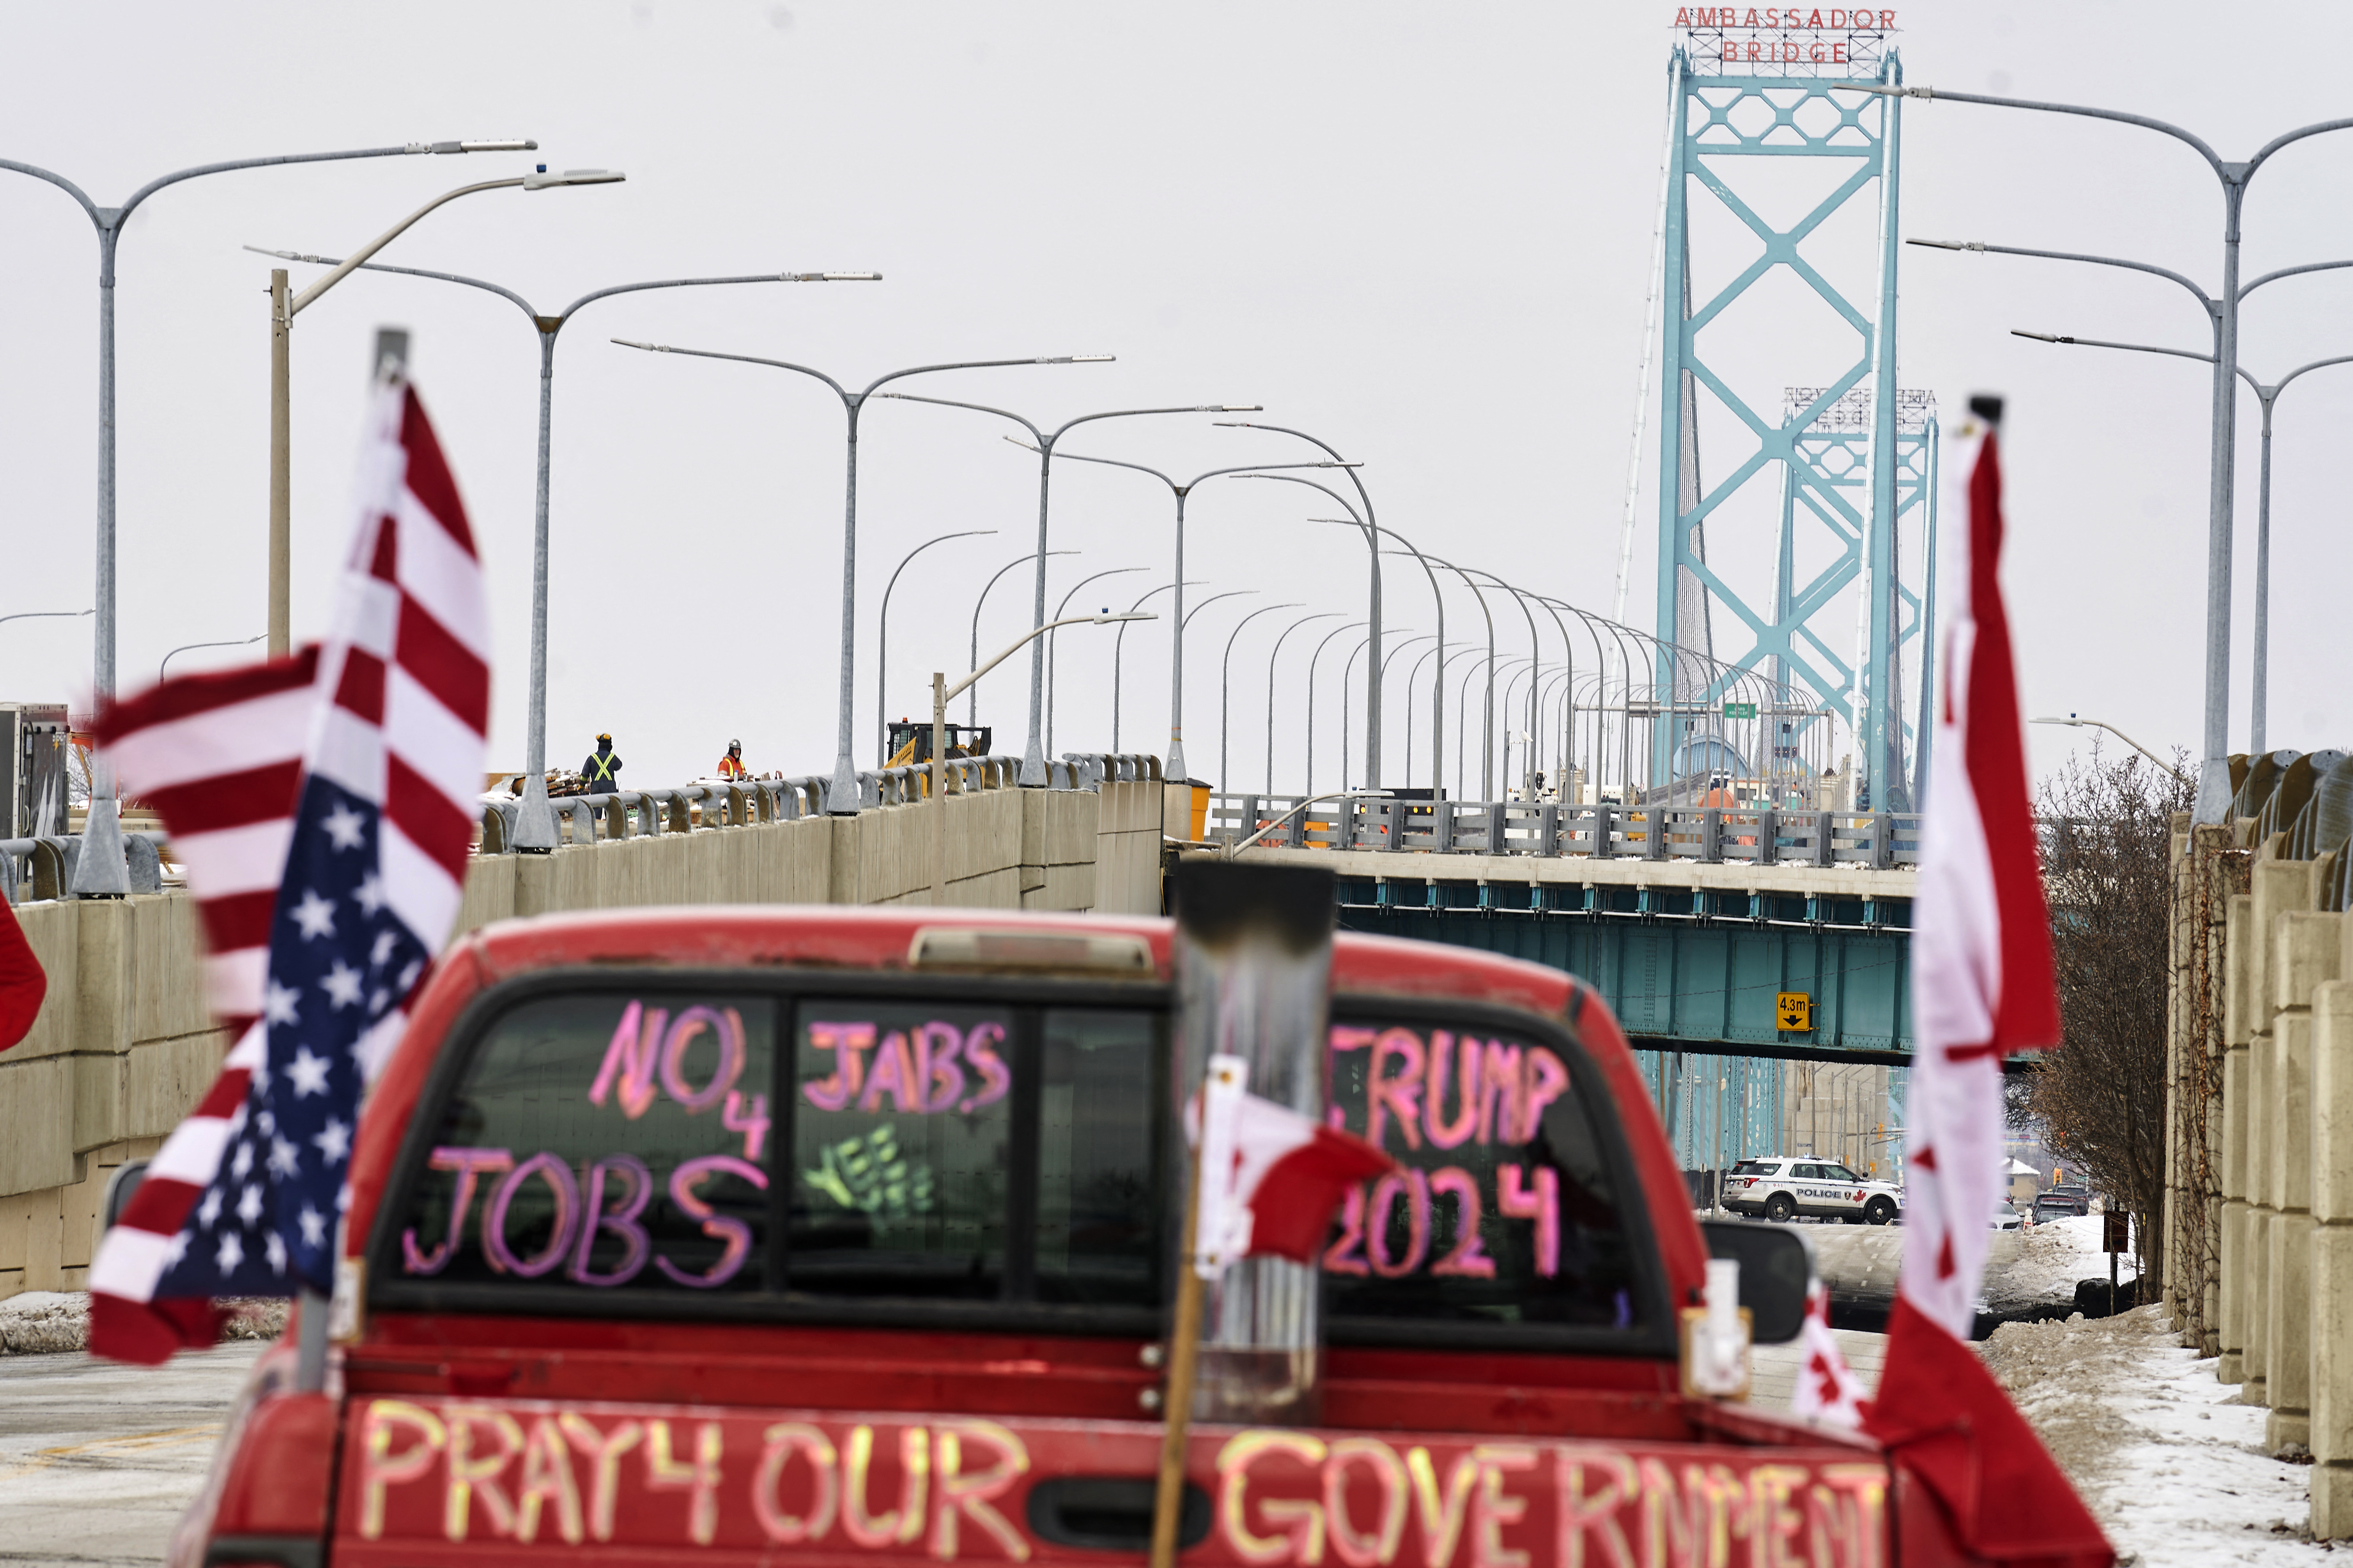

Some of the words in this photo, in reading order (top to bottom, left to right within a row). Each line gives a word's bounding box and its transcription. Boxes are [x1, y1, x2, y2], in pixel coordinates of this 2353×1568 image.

[1674, 6, 1896, 29] AMBASSADOR
[1723, 41, 1846, 63] BRIDGE
[1780, 997, 1805, 1011] 4.3m
[589, 999, 747, 1119] NO
[802, 1021, 1012, 1114] JABS
[721, 1090, 771, 1161] 4
[402, 1146, 770, 1287] JOBS
[1321, 1163, 1560, 1279] 2024
[1797, 1188, 1842, 1199] POLICE
[358, 1398, 643, 1544] PRAY
[645, 1418, 723, 1546] 4
[753, 1418, 1031, 1561] OUR
[1216, 1428, 1890, 1568] GOVERNMENT
